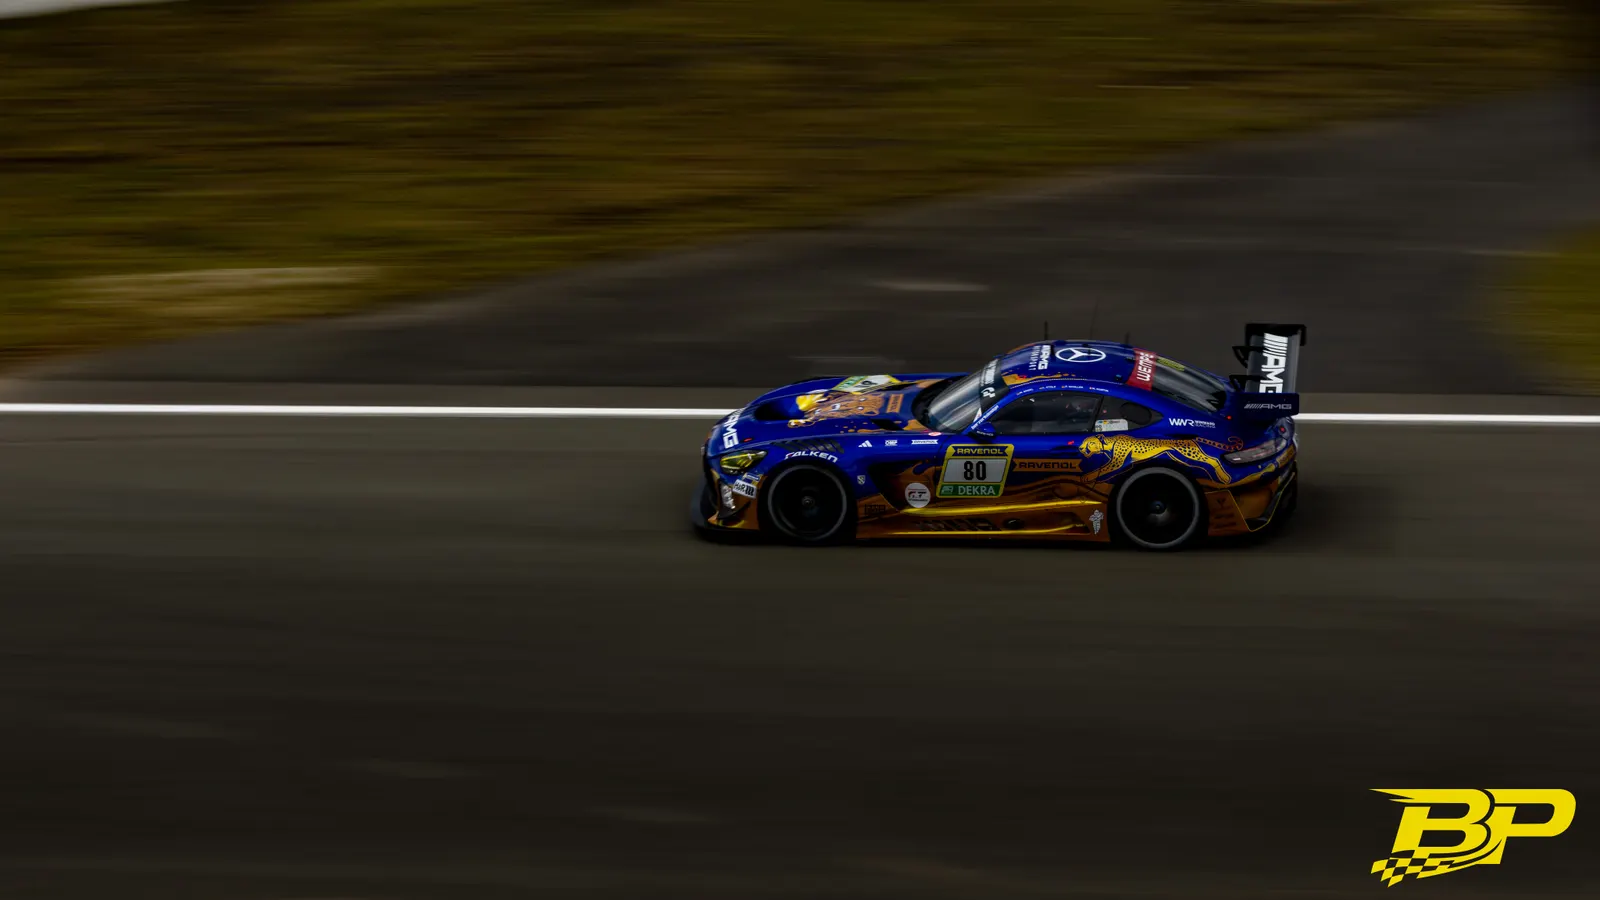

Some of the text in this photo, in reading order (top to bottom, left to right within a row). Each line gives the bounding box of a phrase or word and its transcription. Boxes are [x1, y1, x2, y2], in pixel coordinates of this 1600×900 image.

[1037, 346, 1051, 371] AMG
[784, 450, 839, 464] FALKEN
[963, 460, 986, 481] 80
[1019, 461, 1077, 470] RAVENOL
[957, 485, 996, 496] DEKRA
